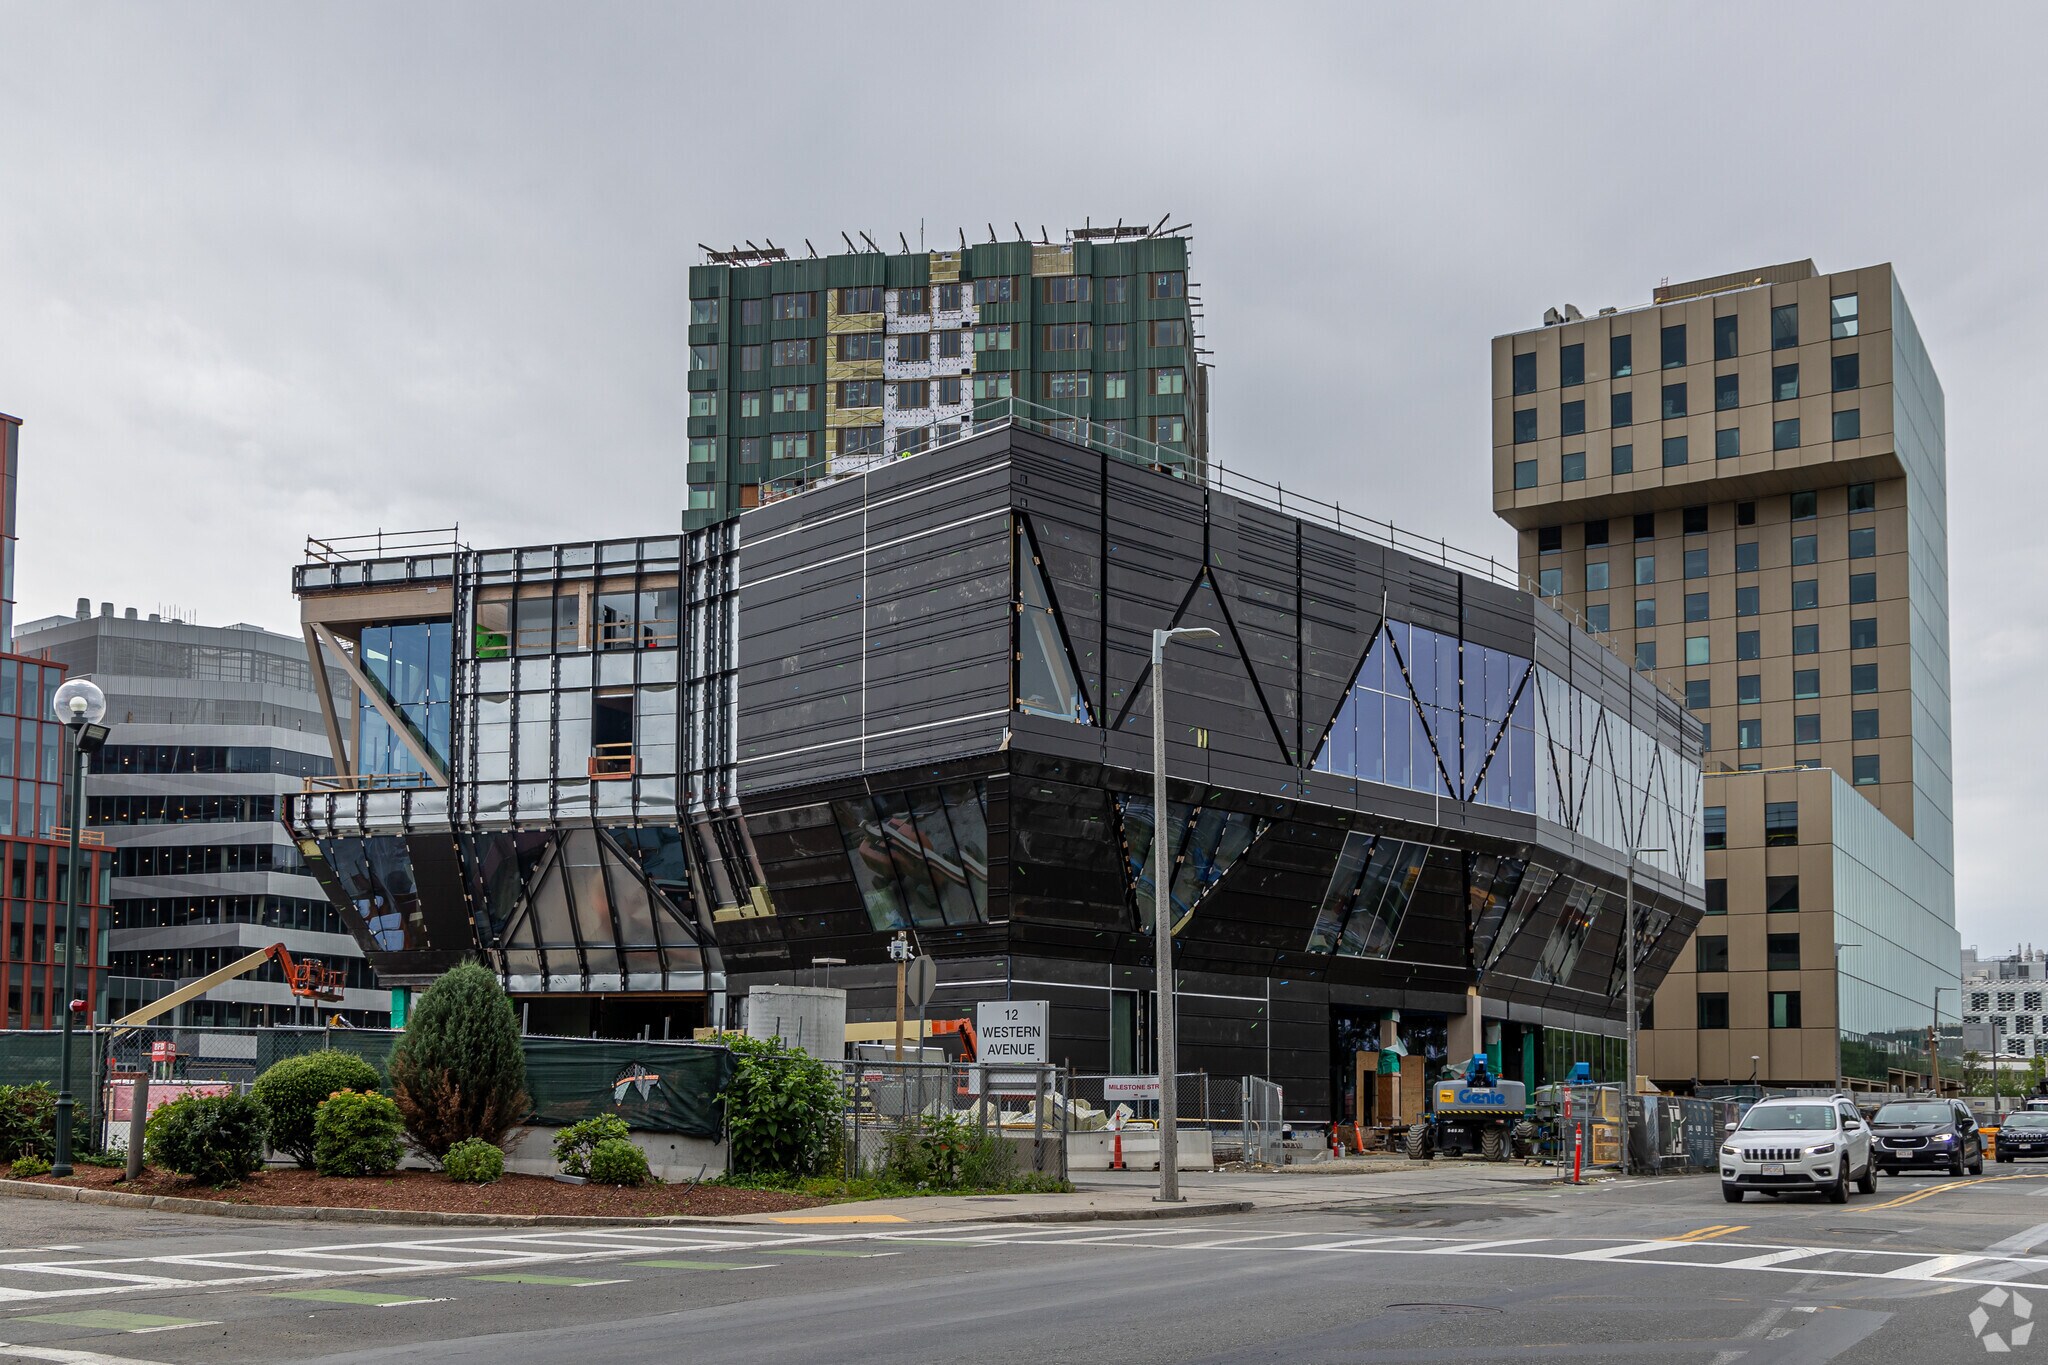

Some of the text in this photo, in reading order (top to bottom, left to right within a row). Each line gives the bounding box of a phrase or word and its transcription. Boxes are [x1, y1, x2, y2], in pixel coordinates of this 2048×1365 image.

[1005, 1009, 1018, 1020] 12
[982, 1026, 1040, 1038] WESTERN
[987, 1043, 1035, 1055] AVENUE
[1458, 1089, 1505, 1104] Genie
